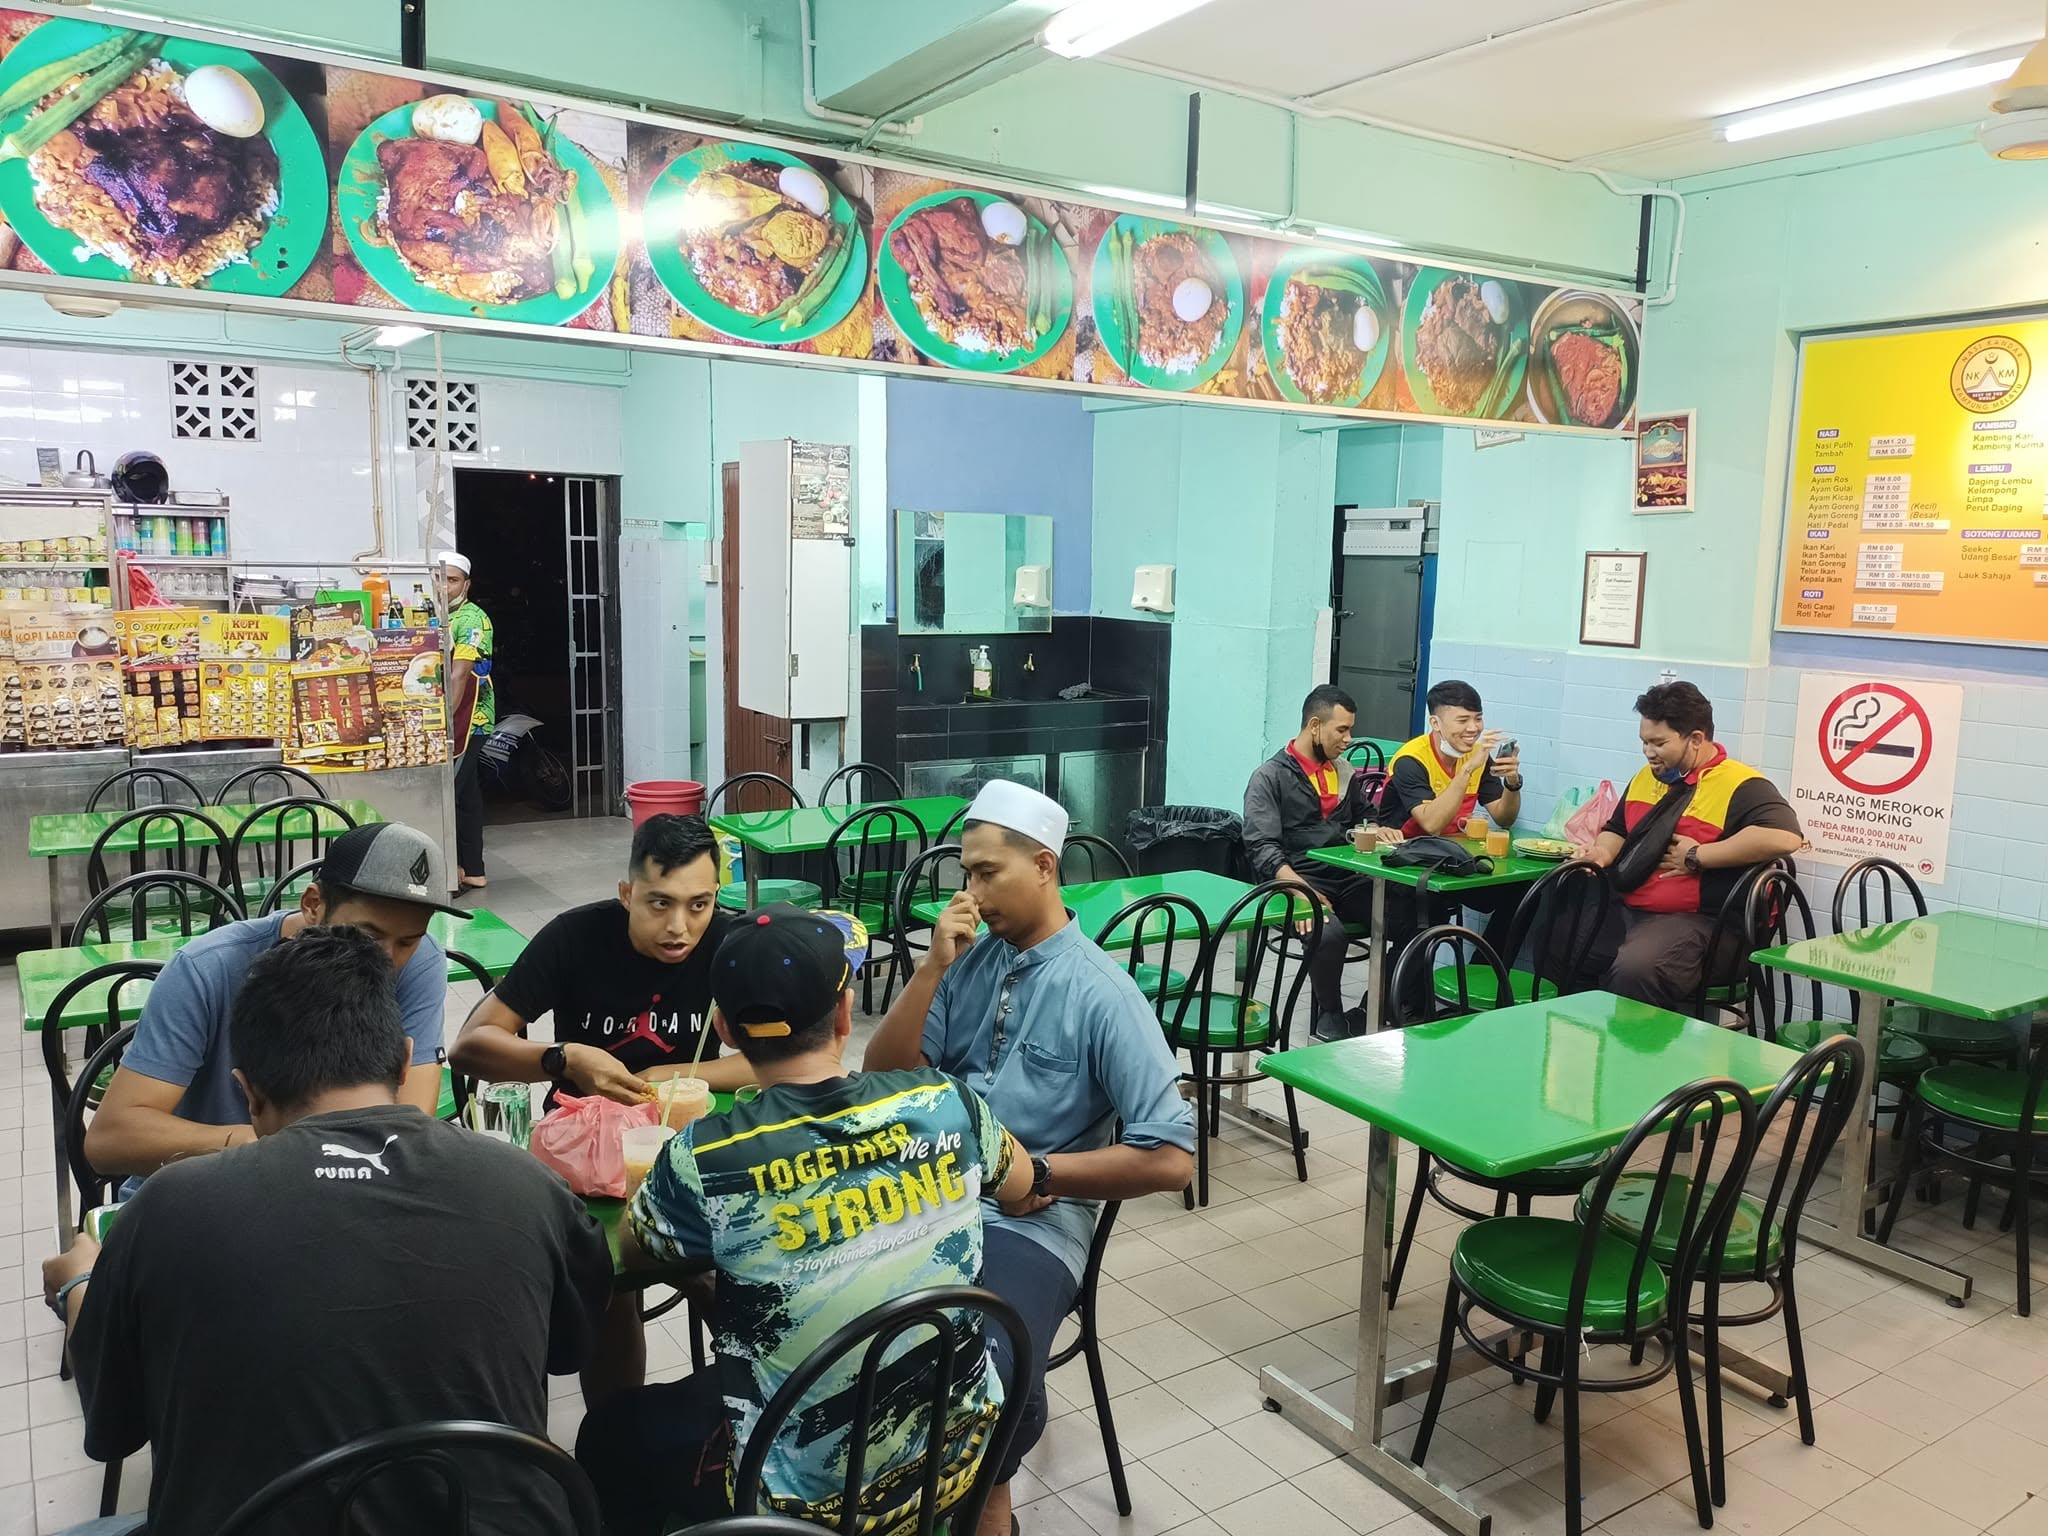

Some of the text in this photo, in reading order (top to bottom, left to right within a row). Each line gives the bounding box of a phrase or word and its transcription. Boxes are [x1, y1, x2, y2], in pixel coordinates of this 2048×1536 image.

[1966, 369, 2015, 380] NK KM
[1956, 383, 2023, 410] KAMPUNG MELAYU
[1974, 421, 2015, 430] KAMBING
[1819, 430, 1838, 438] NASI
[1973, 434, 2013, 442] Kambing
[1815, 442, 1832, 450] Nasi
[1972, 443, 2012, 451] Kambing
[1815, 450, 1844, 458] Tambah
[1974, 464, 2005, 472] LEMBU
[1812, 477, 1832, 485] Ayam
[1968, 478, 2000, 486] Daging
[1968, 487, 2018, 495] Kelempong
[1810, 494, 1854, 502] Ayam Kicap
[1967, 496, 1994, 504] Limpa
[1809, 503, 1860, 512] Ayam Goreng
[1910, 502, 1938, 511] (Kecil)
[1966, 504, 2023, 513] Perut Daging
[1808, 512, 1858, 520] Ayam Goreng
[1910, 512, 1940, 520] (Besar)
[1810, 530, 1828, 538] IKAN
[1964, 530, 2000, 538] SOTONG
[2006, 530, 2039, 538] UDANG
[1961, 553, 1989, 562] Udang
[1818, 560, 1846, 568] Goreng
[1800, 576, 1824, 584] Kepala
[1982, 572, 2012, 581] Sahaja
[1797, 602, 1812, 610] Roti
[1796, 610, 1811, 618] Roti
[232, 620, 260, 629] KOPI
[16, 631, 42, 642] KOPI
[224, 632, 270, 641] JANTAN
[1796, 788, 1945, 820] DILARANG MEROKOK
[1822, 805, 1912, 828] NO SMOKING
[1808, 819, 1923, 844] DENDA RM10,000.00 ATAU
[1822, 831, 1865, 845] PENJARA
[1875, 840, 1908, 851] TAHUN
[581, 1011, 702, 1035] JORDAN
[748, 1122, 913, 1197] TOGETHER
[899, 1137, 931, 1163] We
[935, 1130, 961, 1155] Are
[314, 1166, 372, 1179] PUMA
[770, 1152, 966, 1252] STRONG
